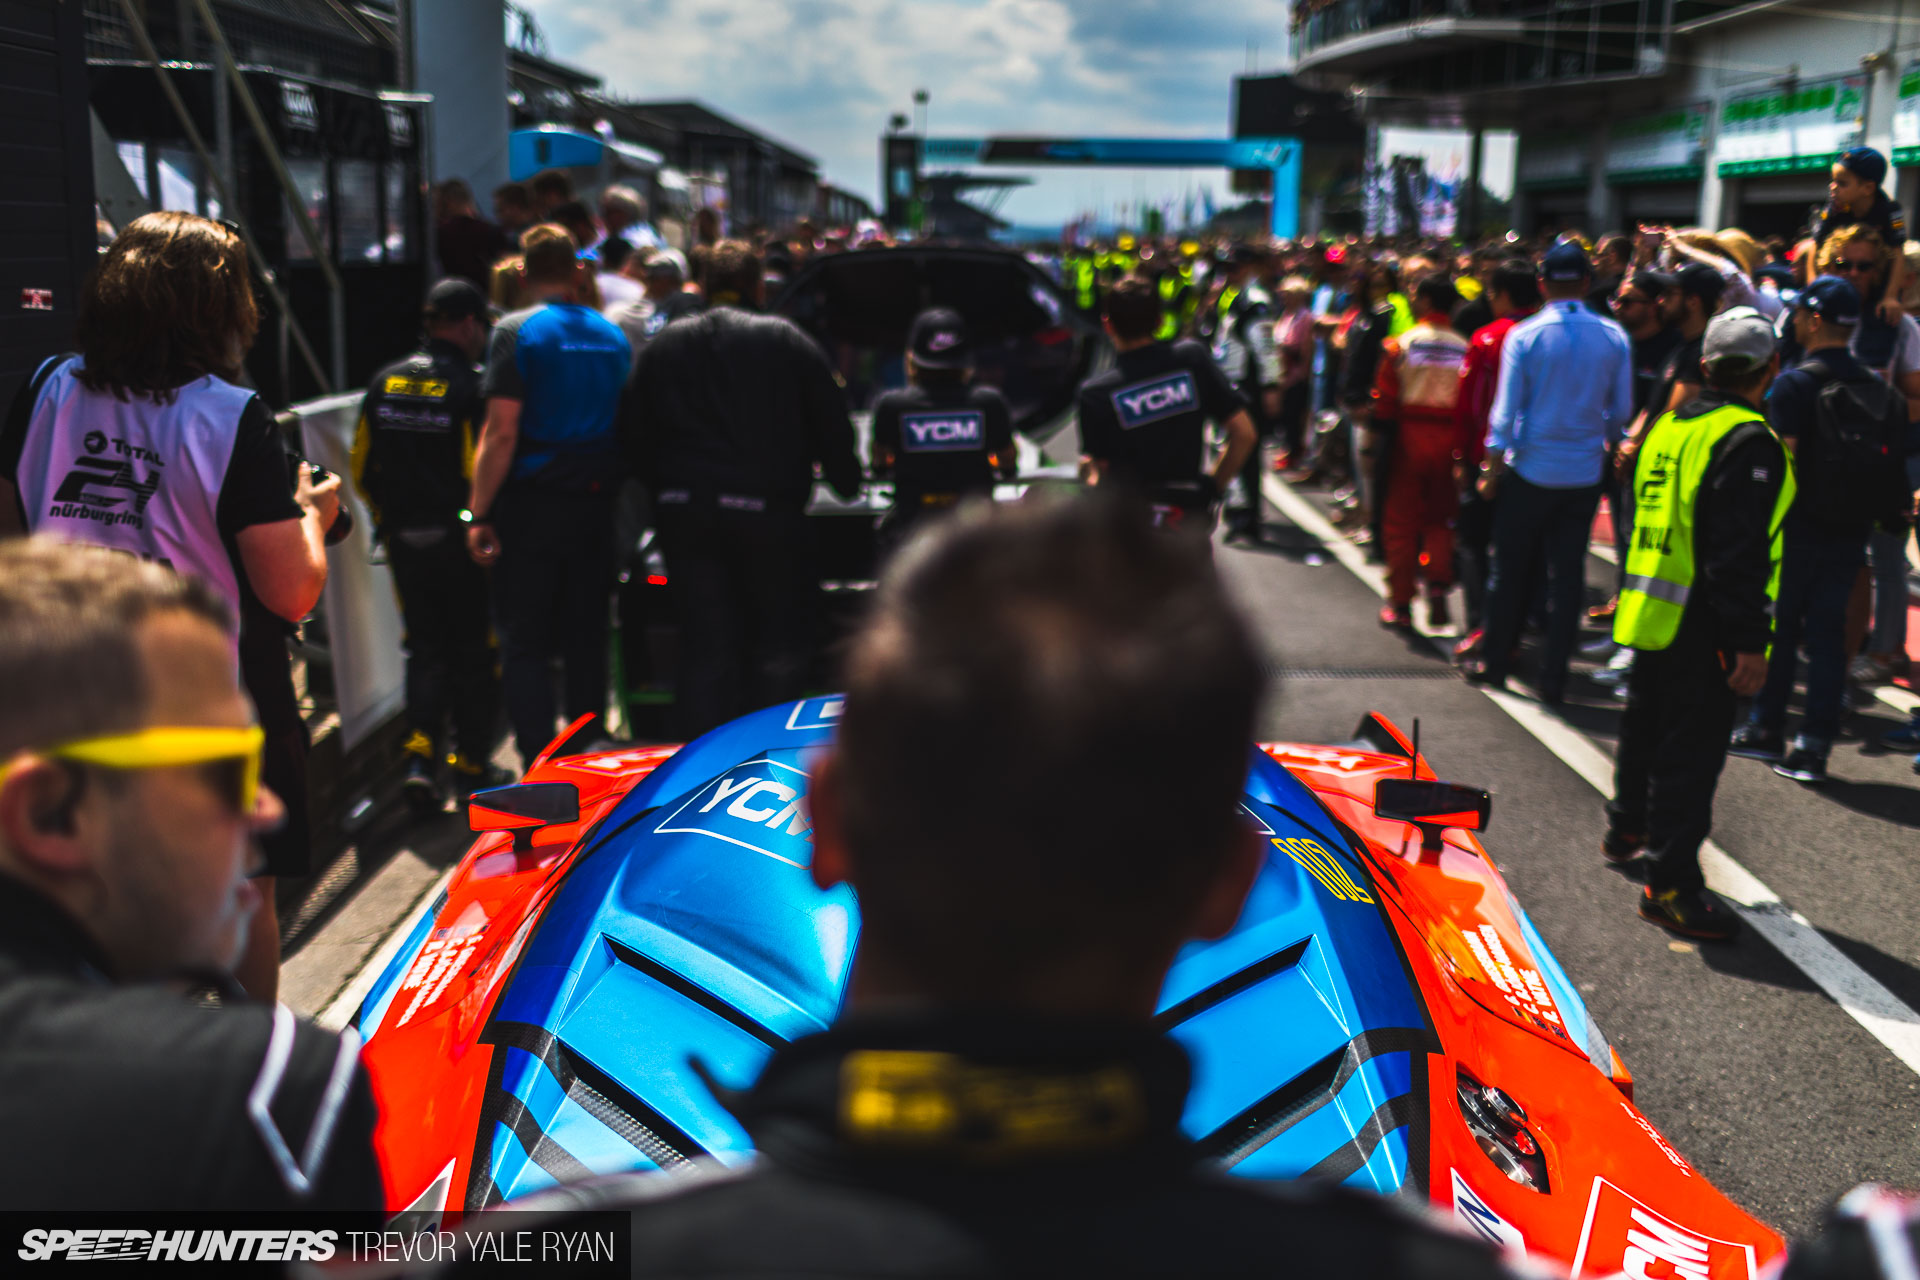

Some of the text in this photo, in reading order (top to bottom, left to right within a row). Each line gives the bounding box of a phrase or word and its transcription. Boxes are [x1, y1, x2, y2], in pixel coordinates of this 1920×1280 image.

[1123, 382, 1191, 416] YCM
[908, 420, 978, 442] YCM
[111, 438, 165, 467] TOTAL
